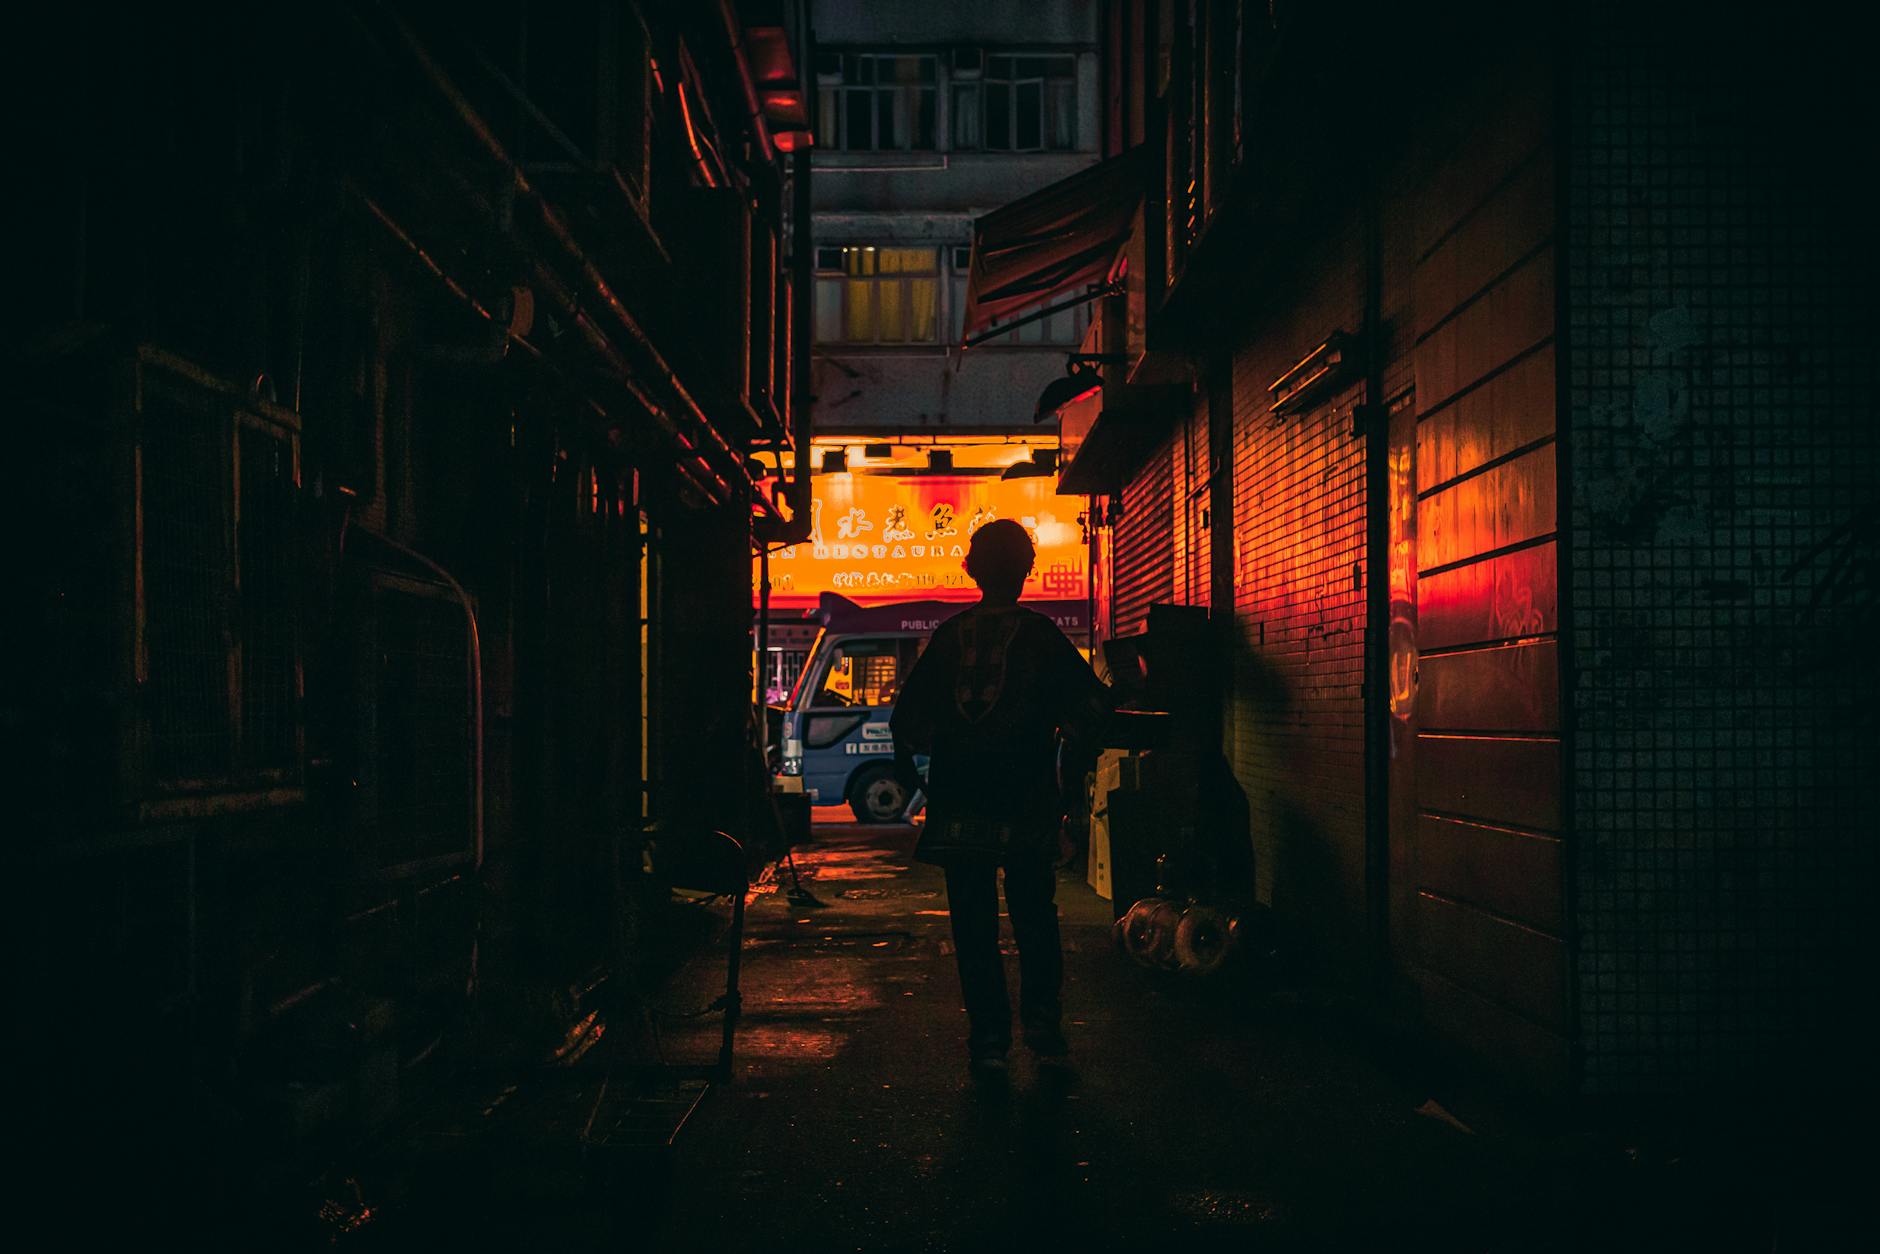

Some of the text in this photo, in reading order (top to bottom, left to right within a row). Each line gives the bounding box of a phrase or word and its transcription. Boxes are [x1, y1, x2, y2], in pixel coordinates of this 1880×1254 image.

[813, 544, 965, 559] RESTAURA
[901, 616, 1080, 631] PUBLIC ATS
